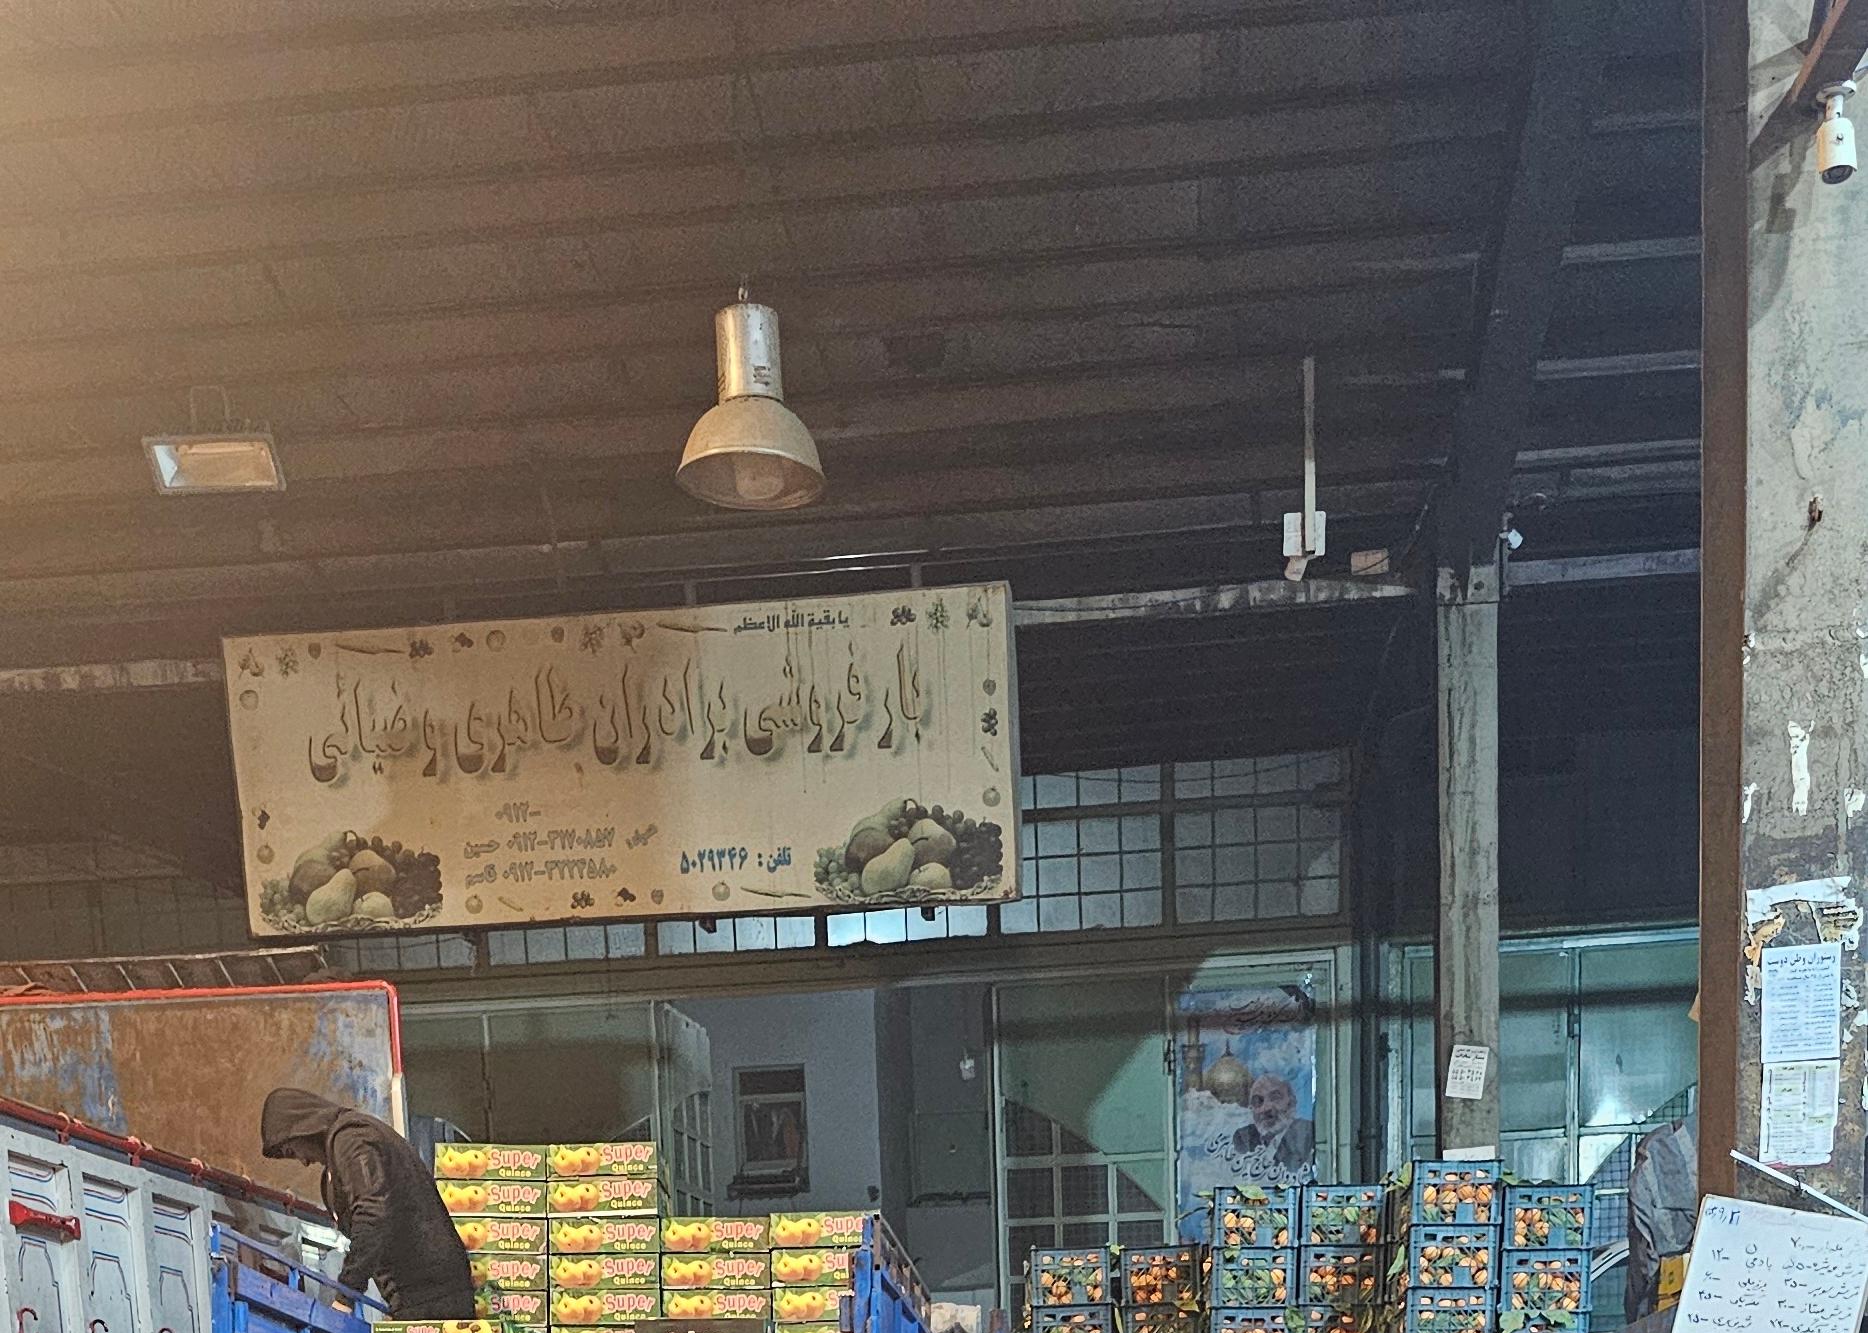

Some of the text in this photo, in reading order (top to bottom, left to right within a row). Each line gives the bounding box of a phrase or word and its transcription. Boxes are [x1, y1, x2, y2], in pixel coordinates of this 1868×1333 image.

[593, 655, 728, 766] برادران
[490, 1149, 541, 1170] Super
[602, 1144, 653, 1164] Super
[490, 1185, 541, 1205] Super
[601, 1180, 652, 1199] Super
[489, 1222, 541, 1242] Super
[605, 1223, 657, 1243] Super
[713, 1221, 764, 1241] Super
[824, 1216, 863, 1236] Supe
[489, 1260, 541, 1280] Super
[604, 1258, 656, 1278] Super
[714, 1258, 766, 1278] Super
[604, 1293, 656, 1313] Super
[715, 1293, 766, 1314] Super
